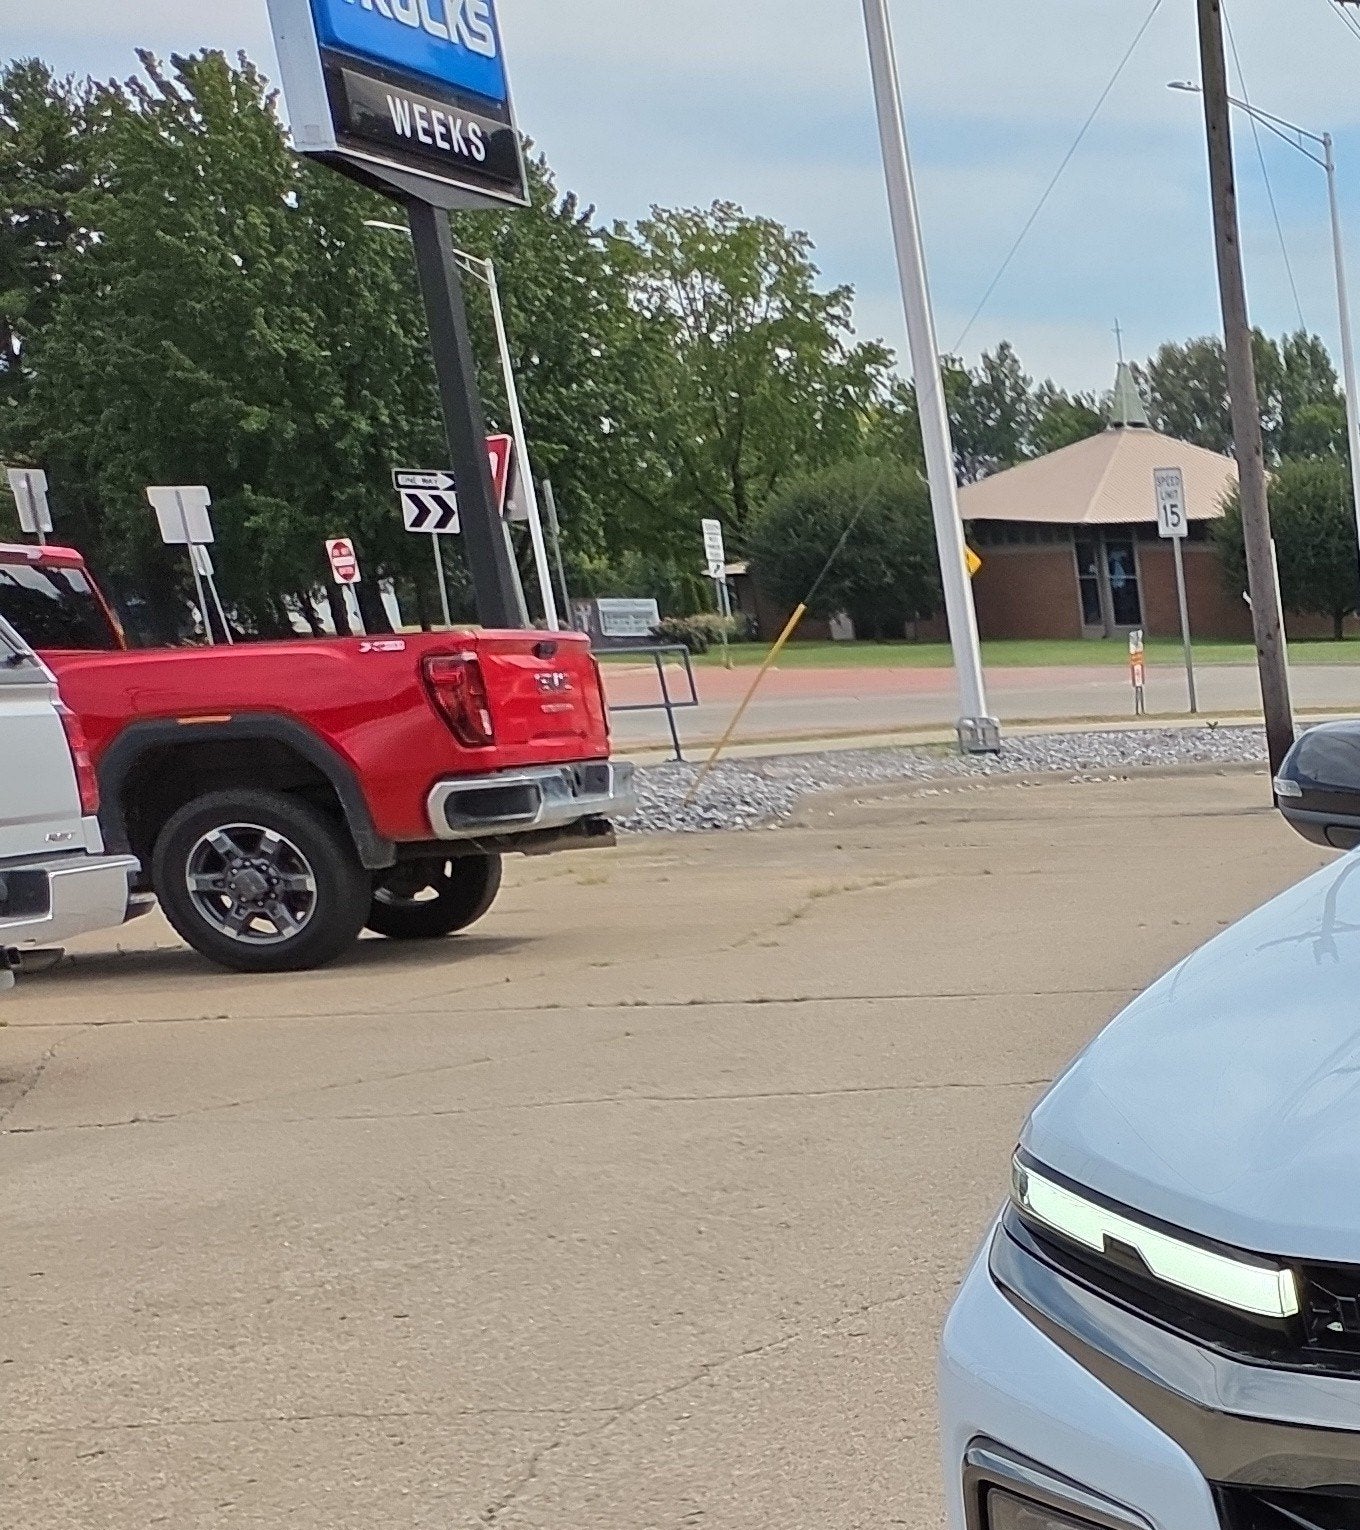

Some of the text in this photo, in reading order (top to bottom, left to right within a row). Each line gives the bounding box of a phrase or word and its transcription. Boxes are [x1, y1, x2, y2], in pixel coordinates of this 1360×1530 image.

[345, 0, 496, 58] UCKS
[386, 94, 486, 162] WEEKS
[1163, 503, 1181, 527] 15
